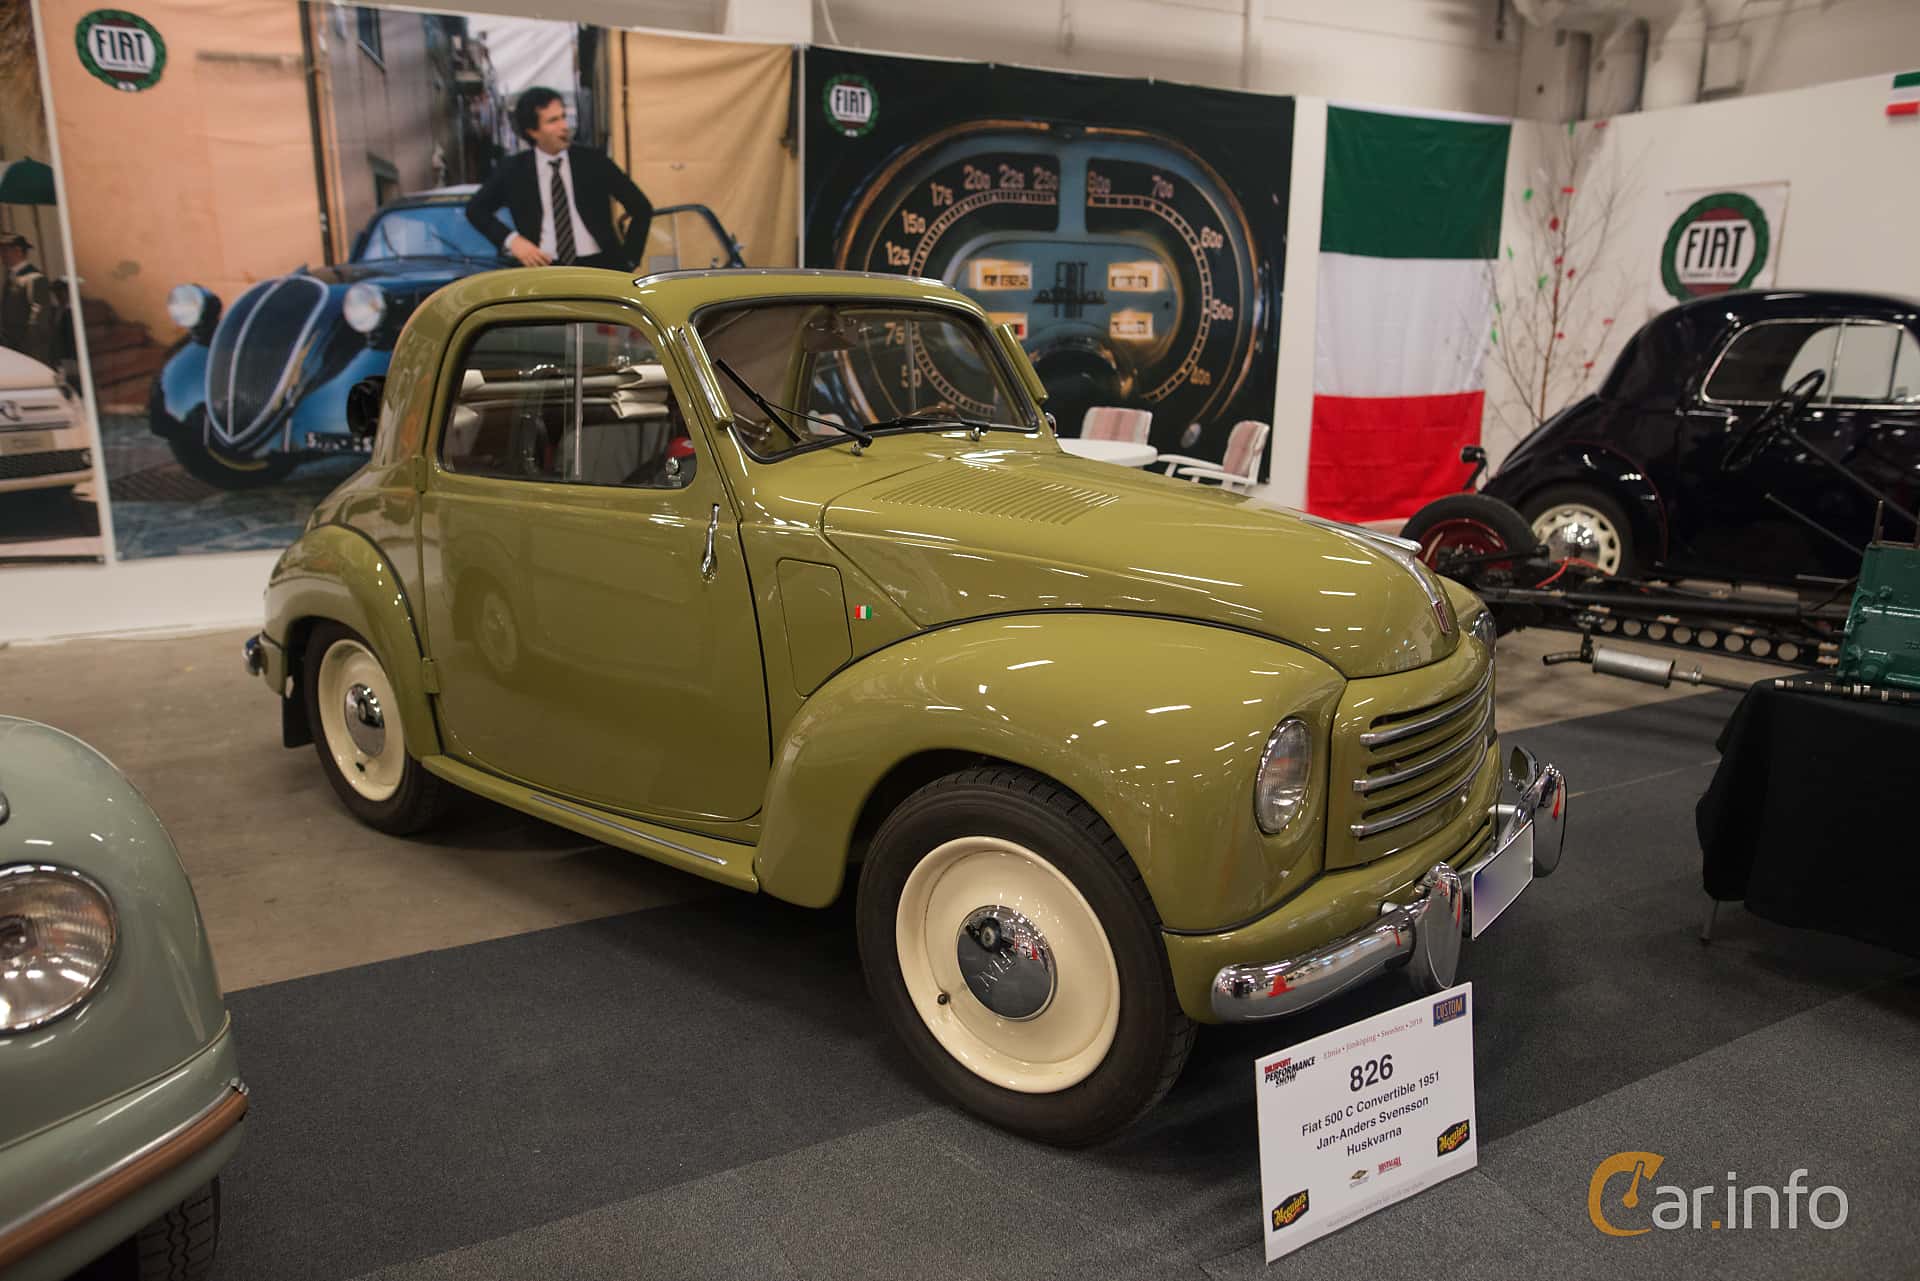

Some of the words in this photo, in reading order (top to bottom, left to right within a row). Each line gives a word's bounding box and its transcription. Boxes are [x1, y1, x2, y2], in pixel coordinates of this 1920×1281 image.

[95, 29, 145, 62] FIAT
[835, 88, 866, 115] FIAT
[902, 209, 926, 235] 150
[886, 240, 910, 266] 125
[1684, 226, 1747, 269] FIAT
[1436, 997, 1464, 1019] CUSTOM
[1264, 1056, 1316, 1083] PERFORMANCE
[1275, 1072, 1297, 1088] SHOW
[1350, 1054, 1394, 1092] 826
[1302, 1119, 1322, 1136] Fiat
[1325, 1110, 1343, 1127] 500
[1346, 1105, 1354, 1118] C
[1356, 1083, 1416, 1113] Convertible
[1419, 1071, 1440, 1088] 1951
[1317, 1118, 1377, 1150] Jan-Anders
[1380, 1096, 1429, 1123] Svensson
[1347, 1127, 1402, 1156] Huskvarna
